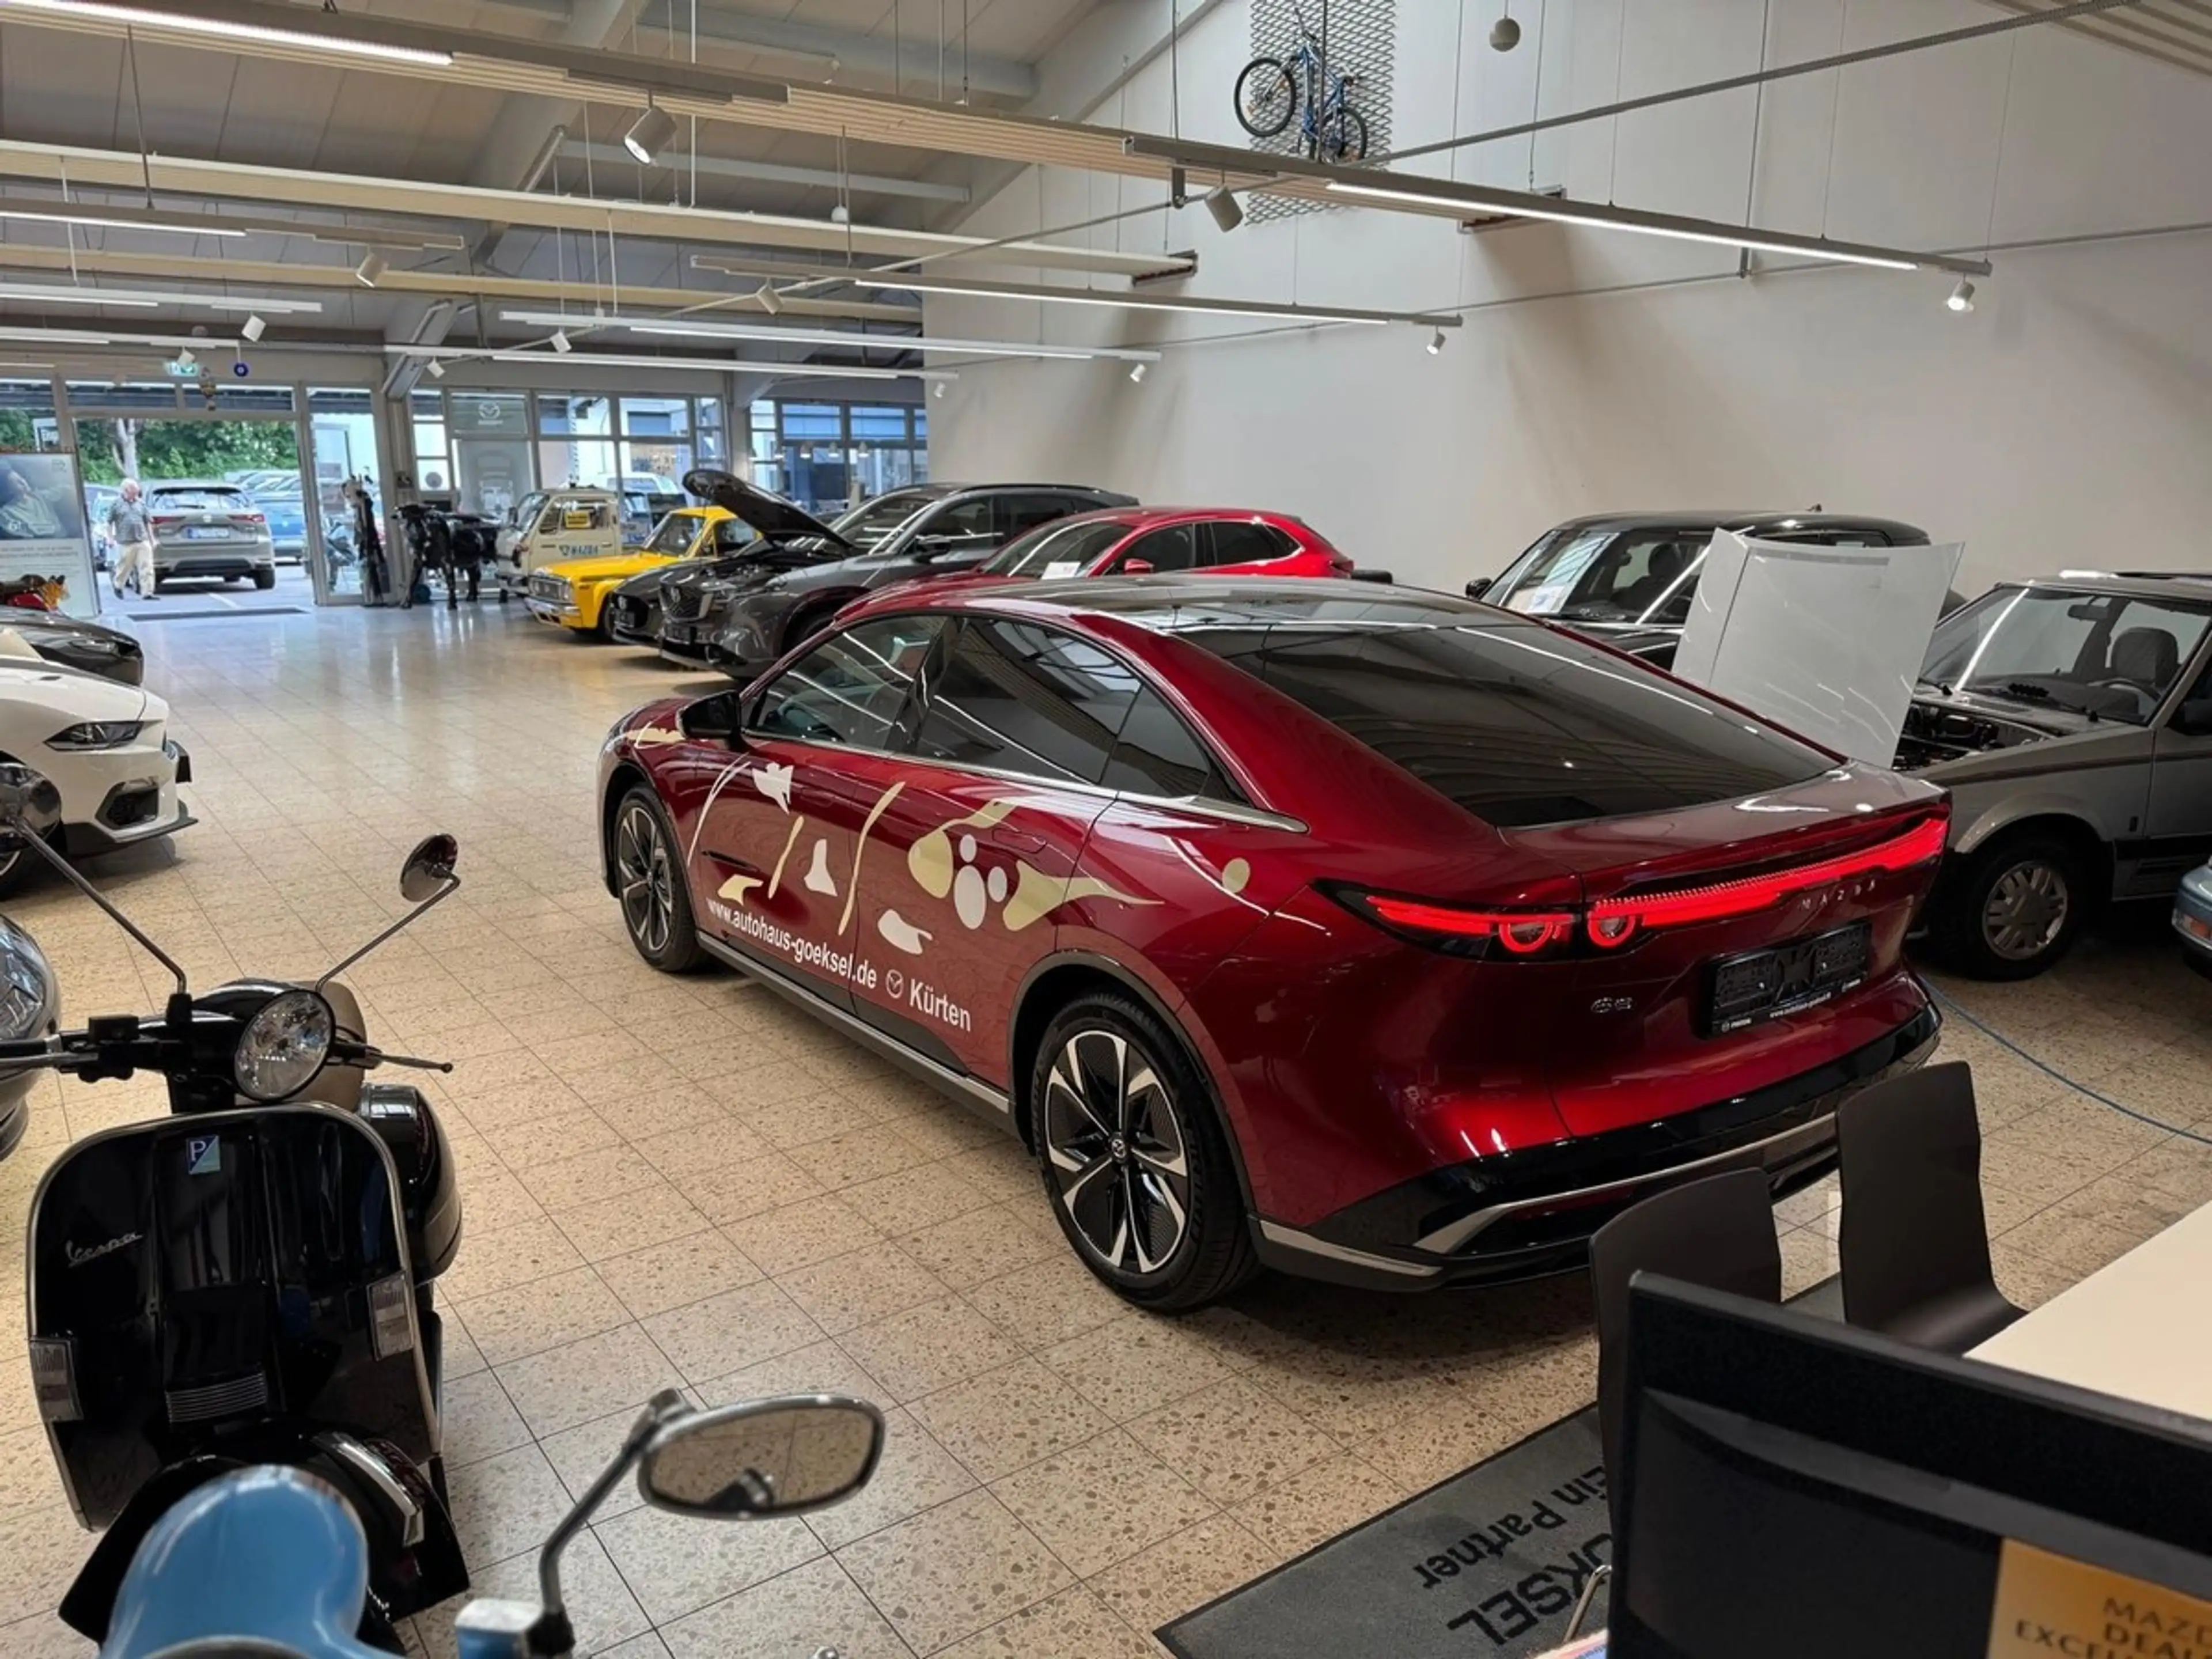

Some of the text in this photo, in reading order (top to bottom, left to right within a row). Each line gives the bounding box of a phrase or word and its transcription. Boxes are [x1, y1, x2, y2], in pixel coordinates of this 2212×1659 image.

[1801, 879, 1876, 910] MAZDA
[706, 897, 971, 1033] www.autohaus-goeksel.de Kürten
[190, 1140, 207, 1162] P
[65, 1230, 143, 1268] Vespa
[1412, 1499, 1567, 1589] Partner
